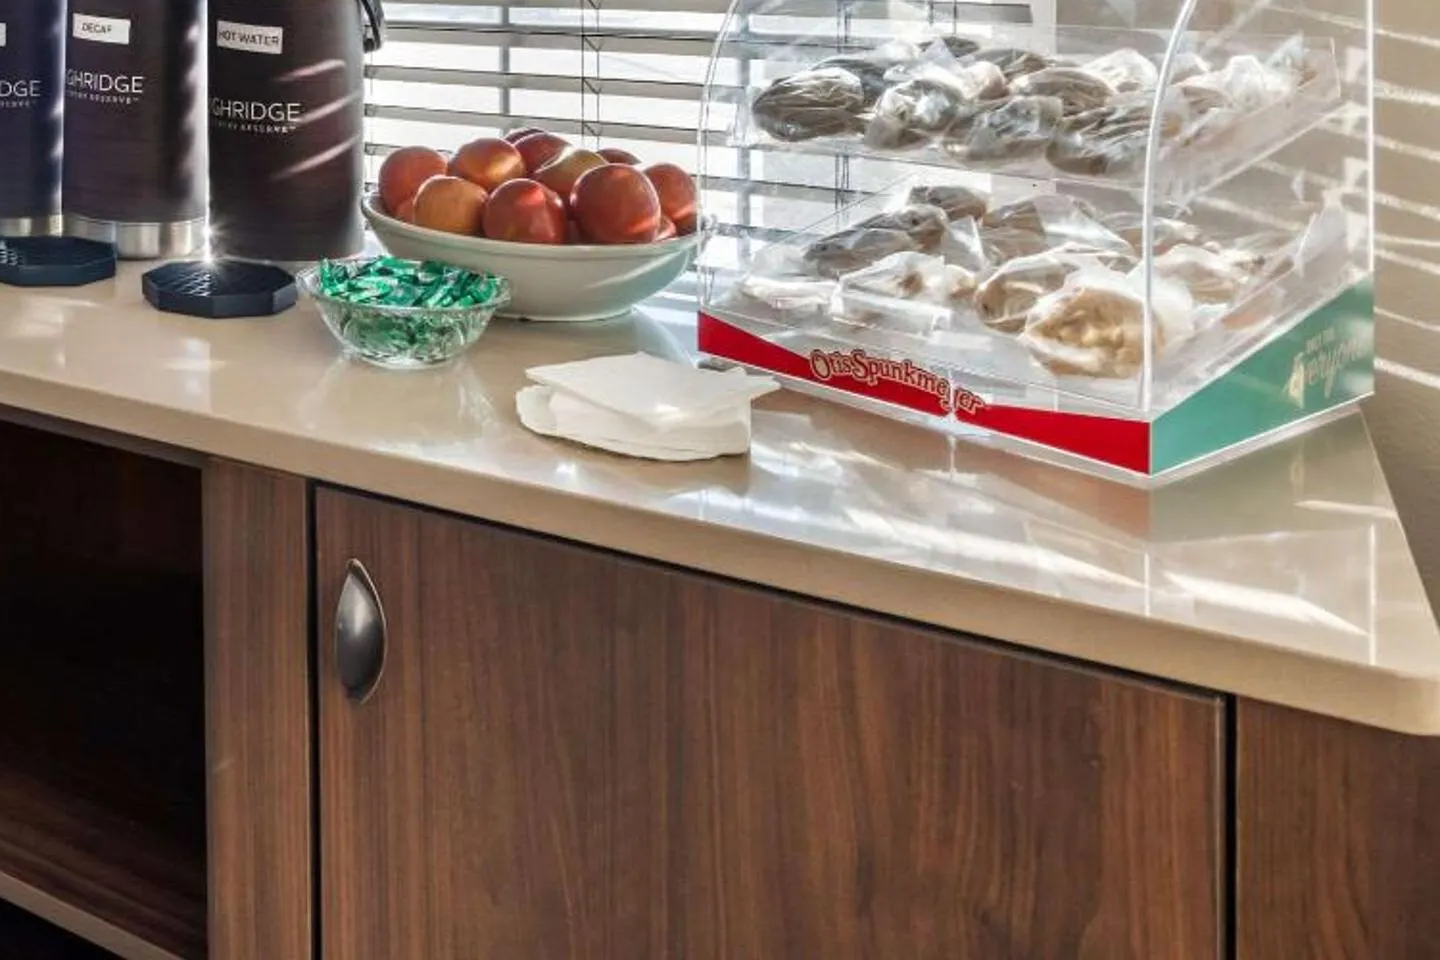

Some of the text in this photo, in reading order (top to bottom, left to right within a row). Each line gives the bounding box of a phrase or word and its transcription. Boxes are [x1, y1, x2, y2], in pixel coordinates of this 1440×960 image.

[82, 22, 112, 34] DECAF
[219, 29, 279, 45] HOT WATER
